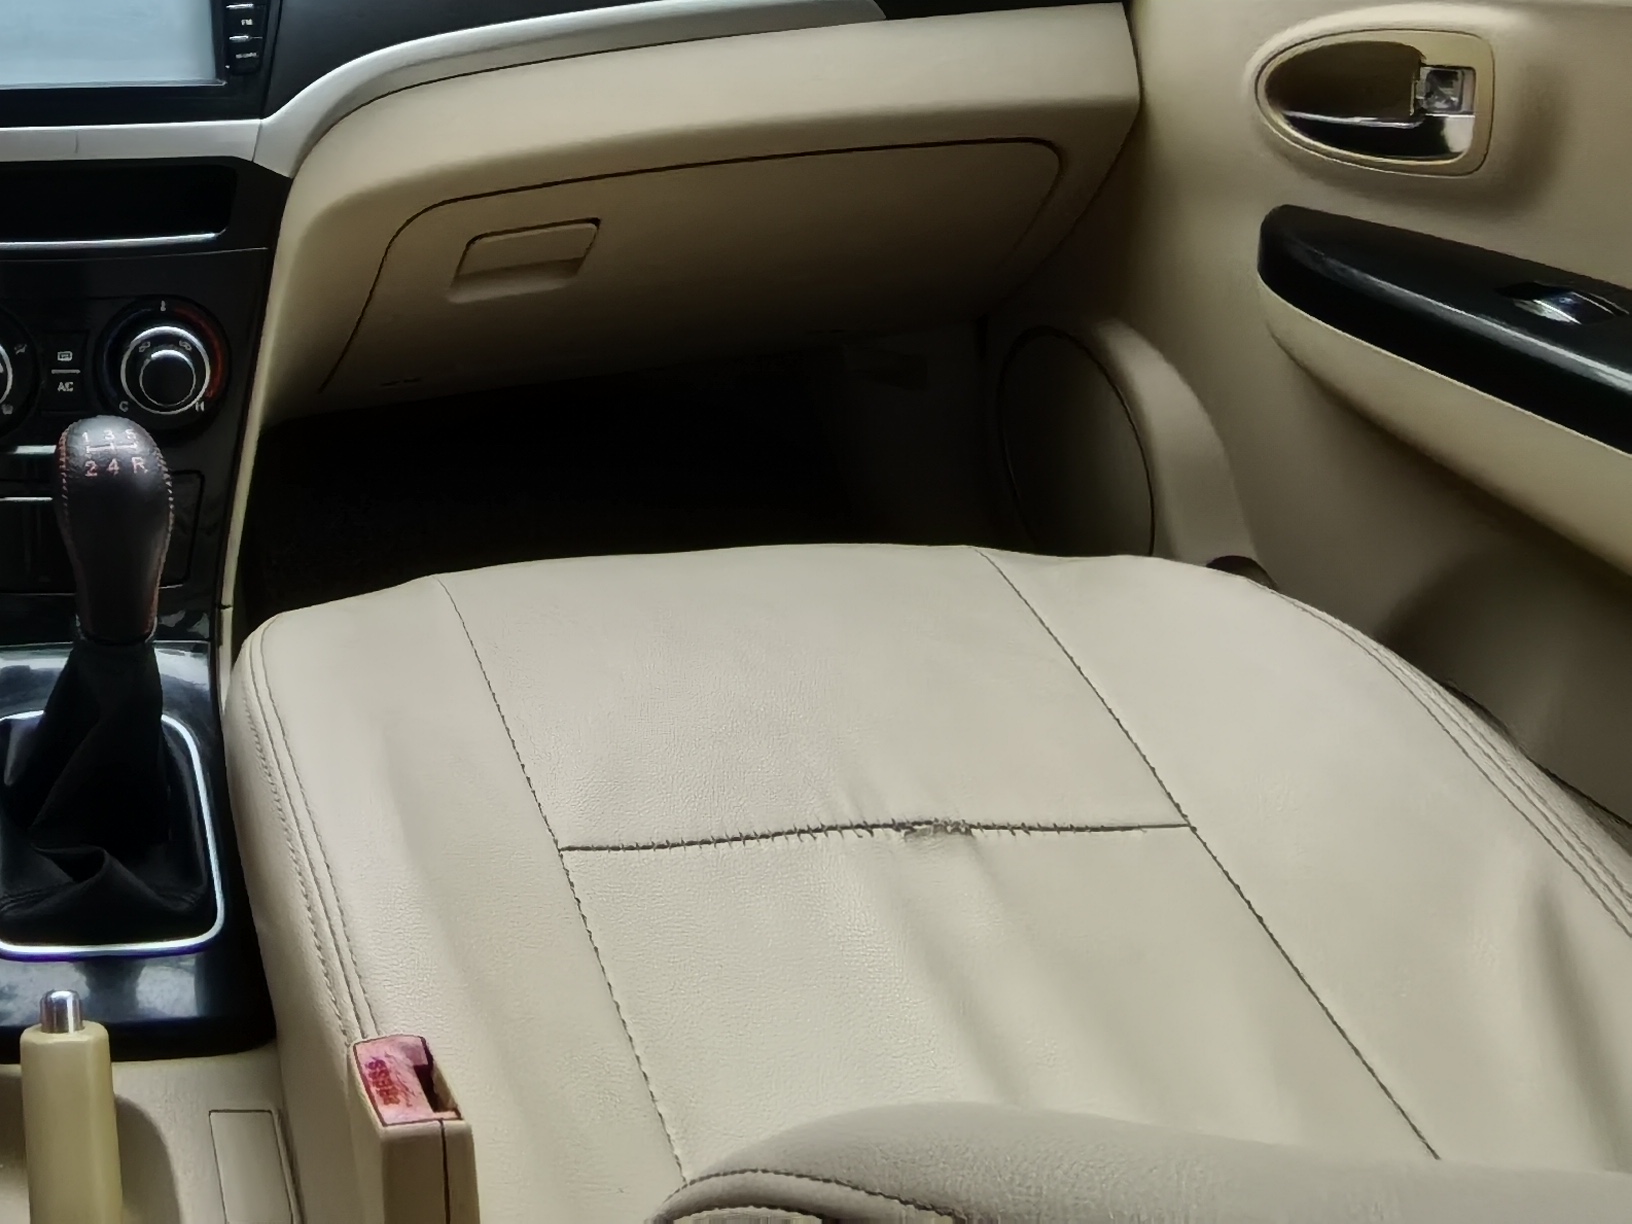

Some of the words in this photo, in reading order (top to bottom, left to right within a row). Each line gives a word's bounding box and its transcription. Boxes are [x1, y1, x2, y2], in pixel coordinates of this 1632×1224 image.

[57, 380, 75, 393] AC
[103, 429, 116, 441] 3
[125, 428, 137, 440] 5
[84, 459, 99, 478] 2
[106, 457, 121, 476] 4
[131, 456, 149, 474] R
